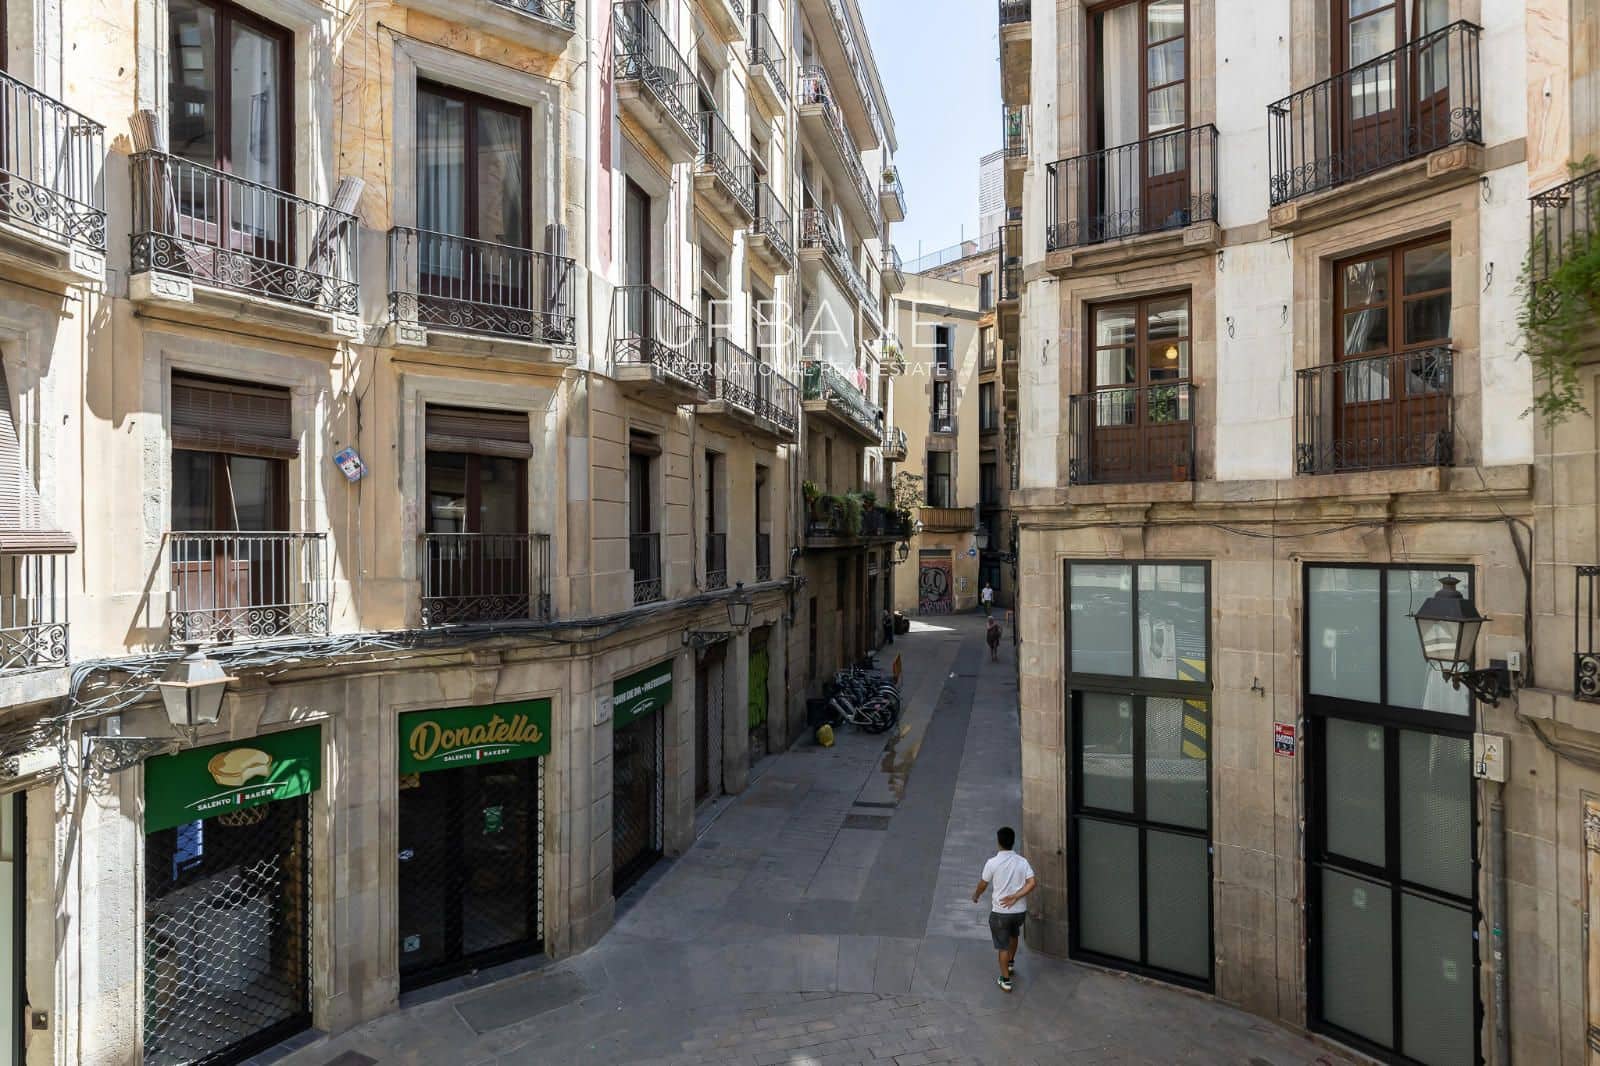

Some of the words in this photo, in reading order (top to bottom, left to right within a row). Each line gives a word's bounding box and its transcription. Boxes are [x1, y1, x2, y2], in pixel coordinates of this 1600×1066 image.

[409, 714, 543, 761] Donatella
[443, 753, 472, 762] SALENTO
[483, 749, 510, 757] BAKERY
[197, 798, 231, 811] SALENTO
[245, 788, 275, 799] BAKERY
